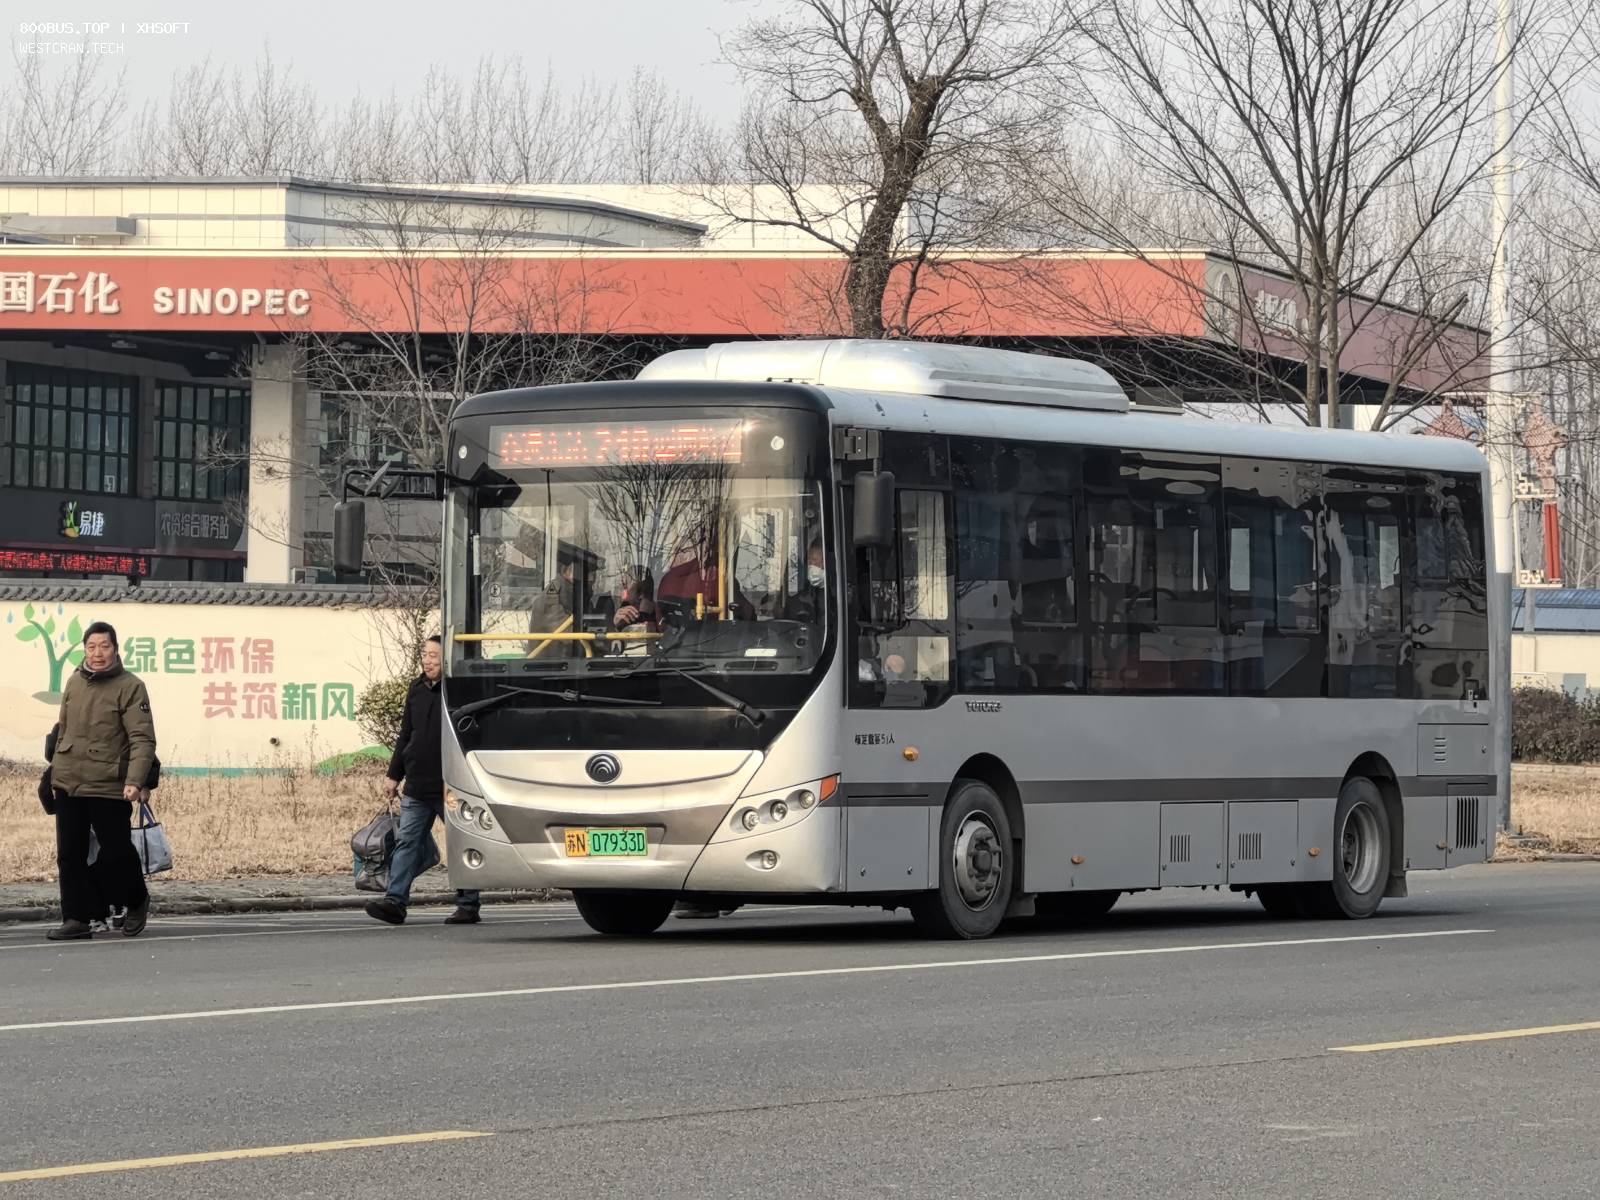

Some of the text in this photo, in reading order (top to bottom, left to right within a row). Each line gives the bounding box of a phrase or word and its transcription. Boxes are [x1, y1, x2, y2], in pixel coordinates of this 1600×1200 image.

[0, 271, 120, 314] 国石化
[153, 286, 311, 315] SINOPEC
[80, 510, 105, 537] 易捷
[123, 636, 275, 674] 绿色环保
[202, 681, 355, 721] 共筑新风
